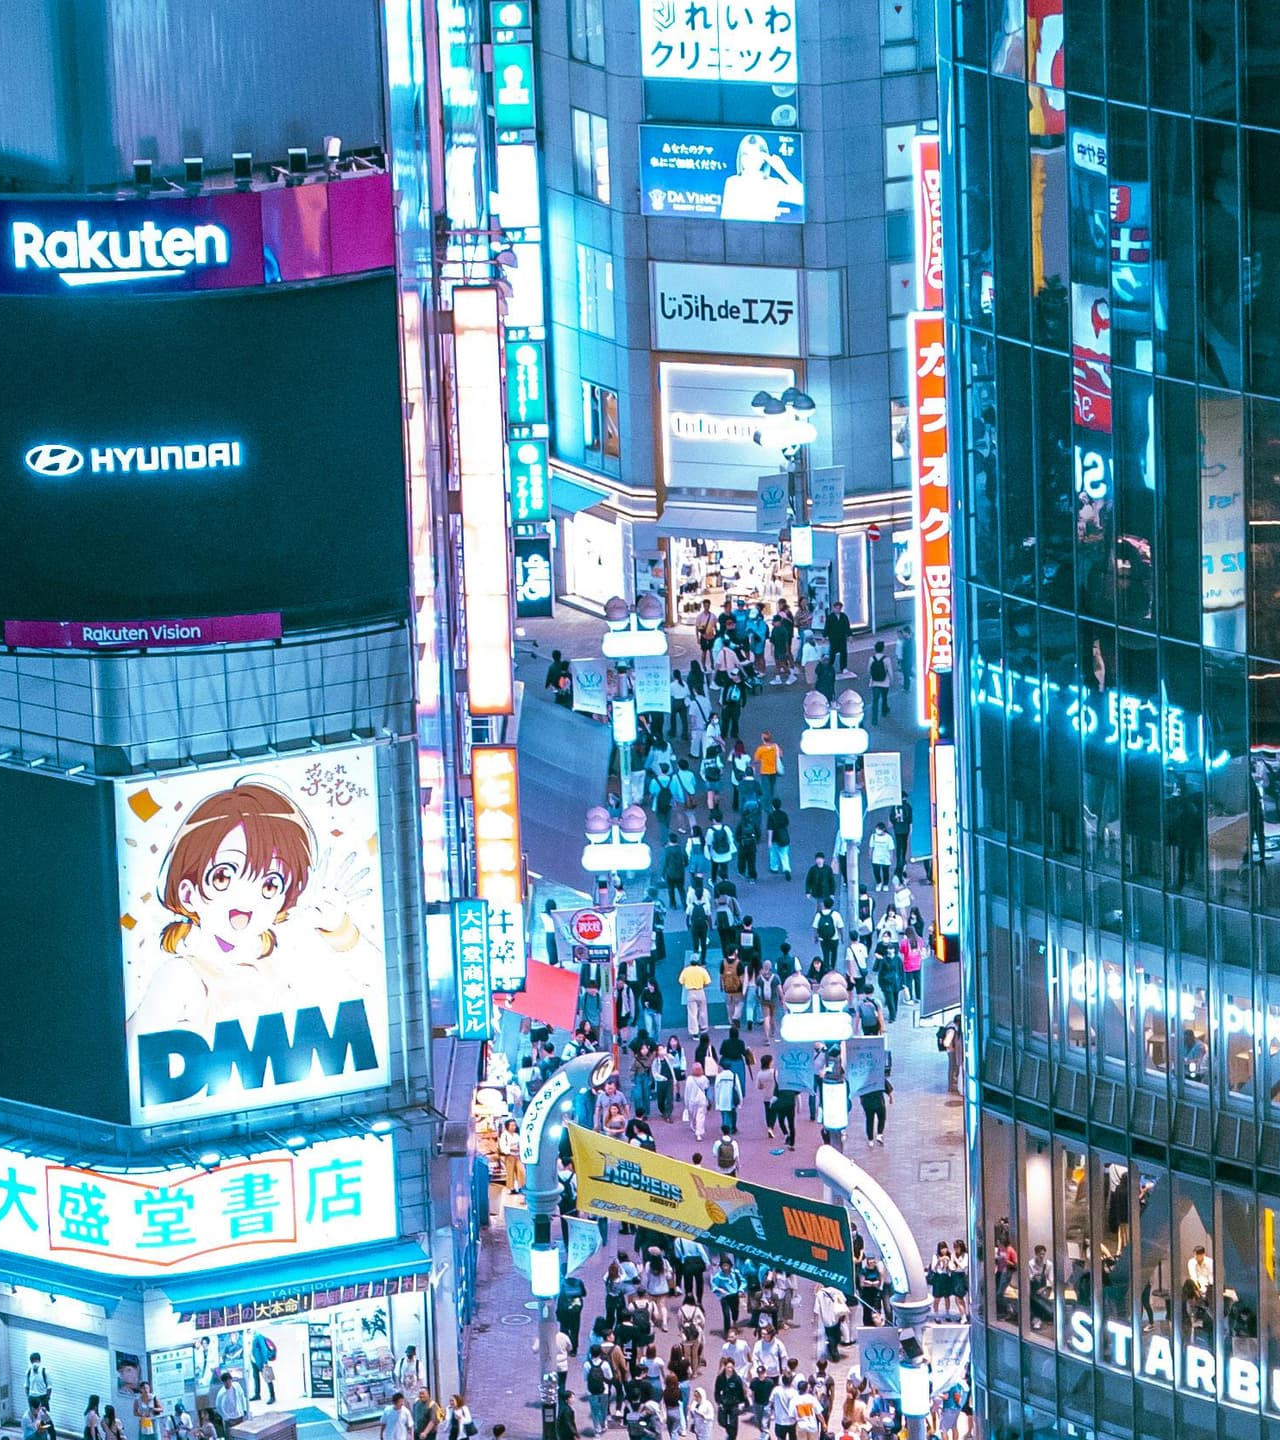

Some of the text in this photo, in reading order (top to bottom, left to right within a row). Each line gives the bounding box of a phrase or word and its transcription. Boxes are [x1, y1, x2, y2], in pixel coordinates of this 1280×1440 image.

[685, 1, 792, 34] れいわ
[651, 41, 792, 72] クリニック
[12, 220, 230, 270] Rakuten
[91, 441, 240, 473] HYUNDAI
[925, 565, 952, 613] BIG
[82, 623, 202, 643] Rakuten Vision
[137, 998, 380, 1108] DMM
[271, 1280, 336, 1298] TAISEIDO
